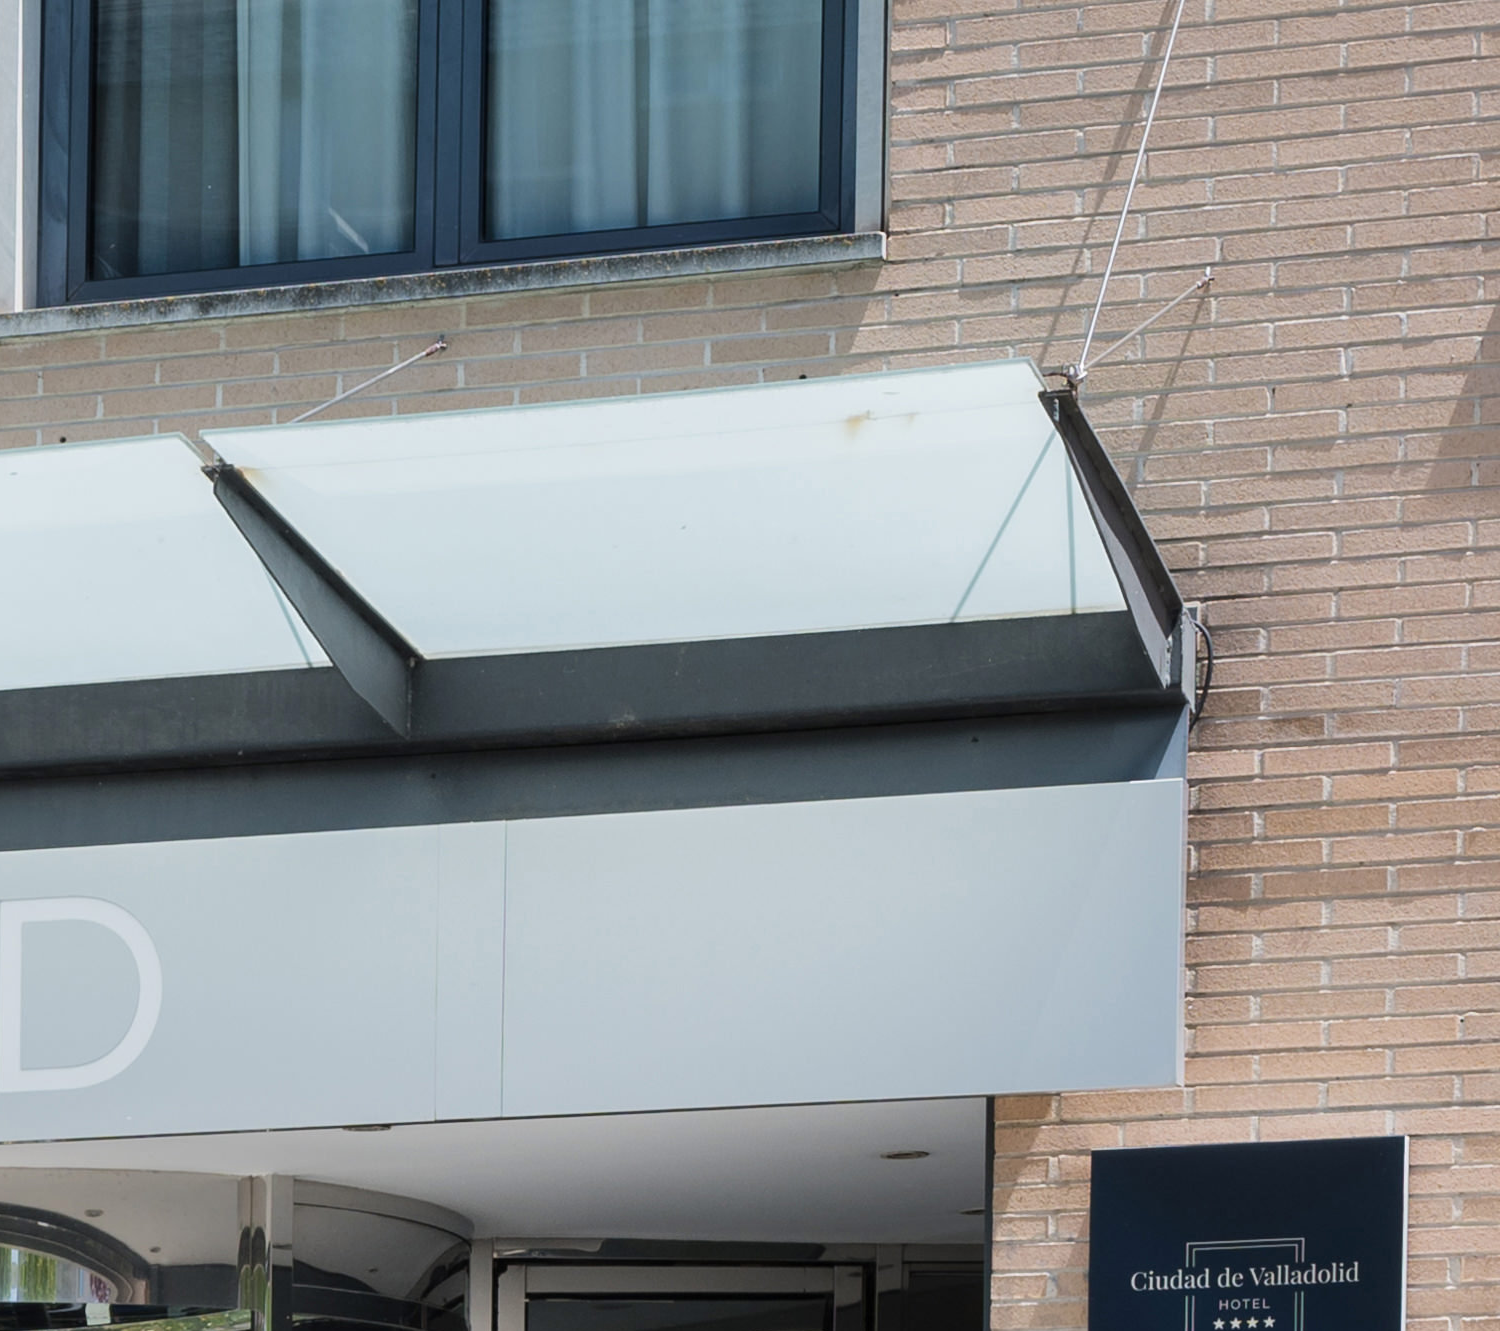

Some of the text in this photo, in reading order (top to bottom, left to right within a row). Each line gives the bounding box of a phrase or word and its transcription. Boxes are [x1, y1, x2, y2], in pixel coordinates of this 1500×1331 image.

[1130, 1261, 1360, 1292] Ciudad de Valladolid
[1218, 1297, 1271, 1311] HOTEL
